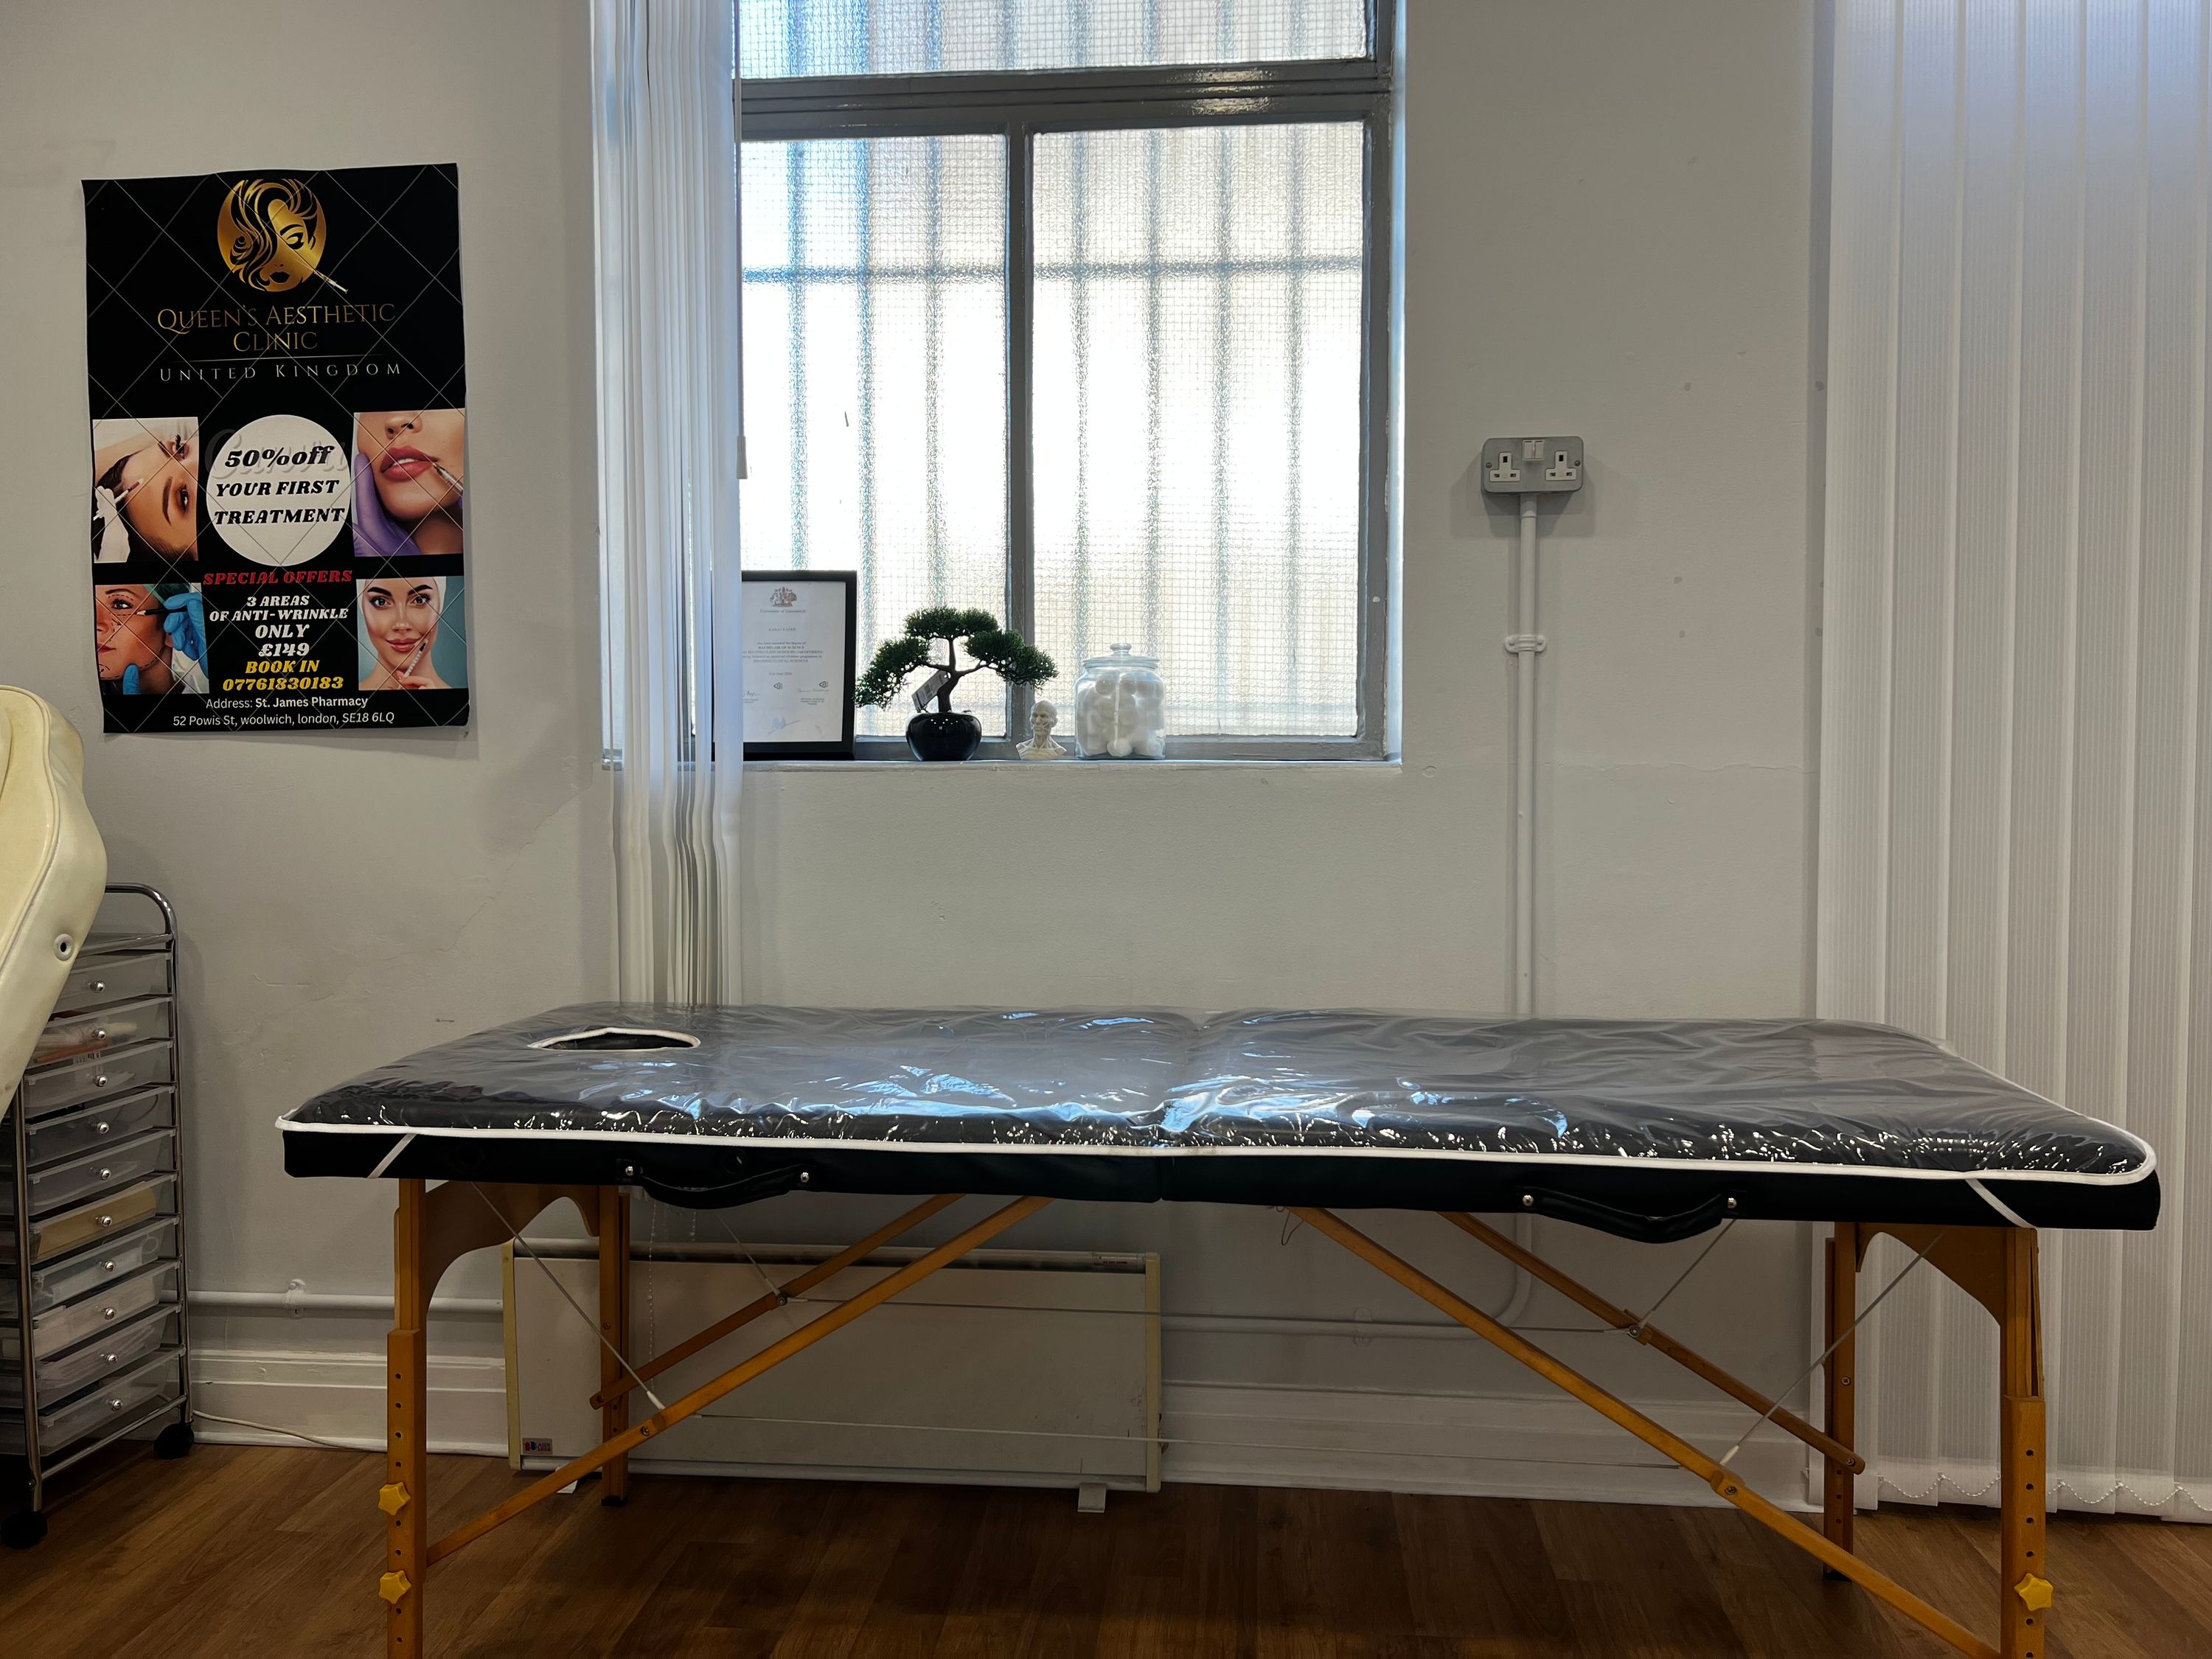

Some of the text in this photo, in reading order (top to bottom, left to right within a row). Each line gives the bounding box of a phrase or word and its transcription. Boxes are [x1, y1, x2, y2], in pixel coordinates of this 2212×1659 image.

[157, 303, 396, 335] QUEEN'S AESTHETIC
[233, 331, 318, 352] CLINIC
[160, 363, 400, 382] UNITED KINGDOM
[225, 445, 335, 467] 50%off
[216, 480, 340, 497] YOUR FIRST
[215, 508, 345, 525] TREATMENT
[203, 570, 352, 585] SPECIAL OFFERS
[246, 595, 310, 607] 3 AREAS
[209, 608, 349, 622] OF ANTI-WRINKLE
[255, 624, 310, 639] ONLY
[258, 642, 310, 657] £149
[245, 660, 320, 674] BOOK IN
[223, 676, 344, 691] 07761830183
[206, 696, 369, 709] Address: St. James Pharmacy
[173, 712, 395, 727] 52 Powis St, woolwich, london, SE18 6LQ
